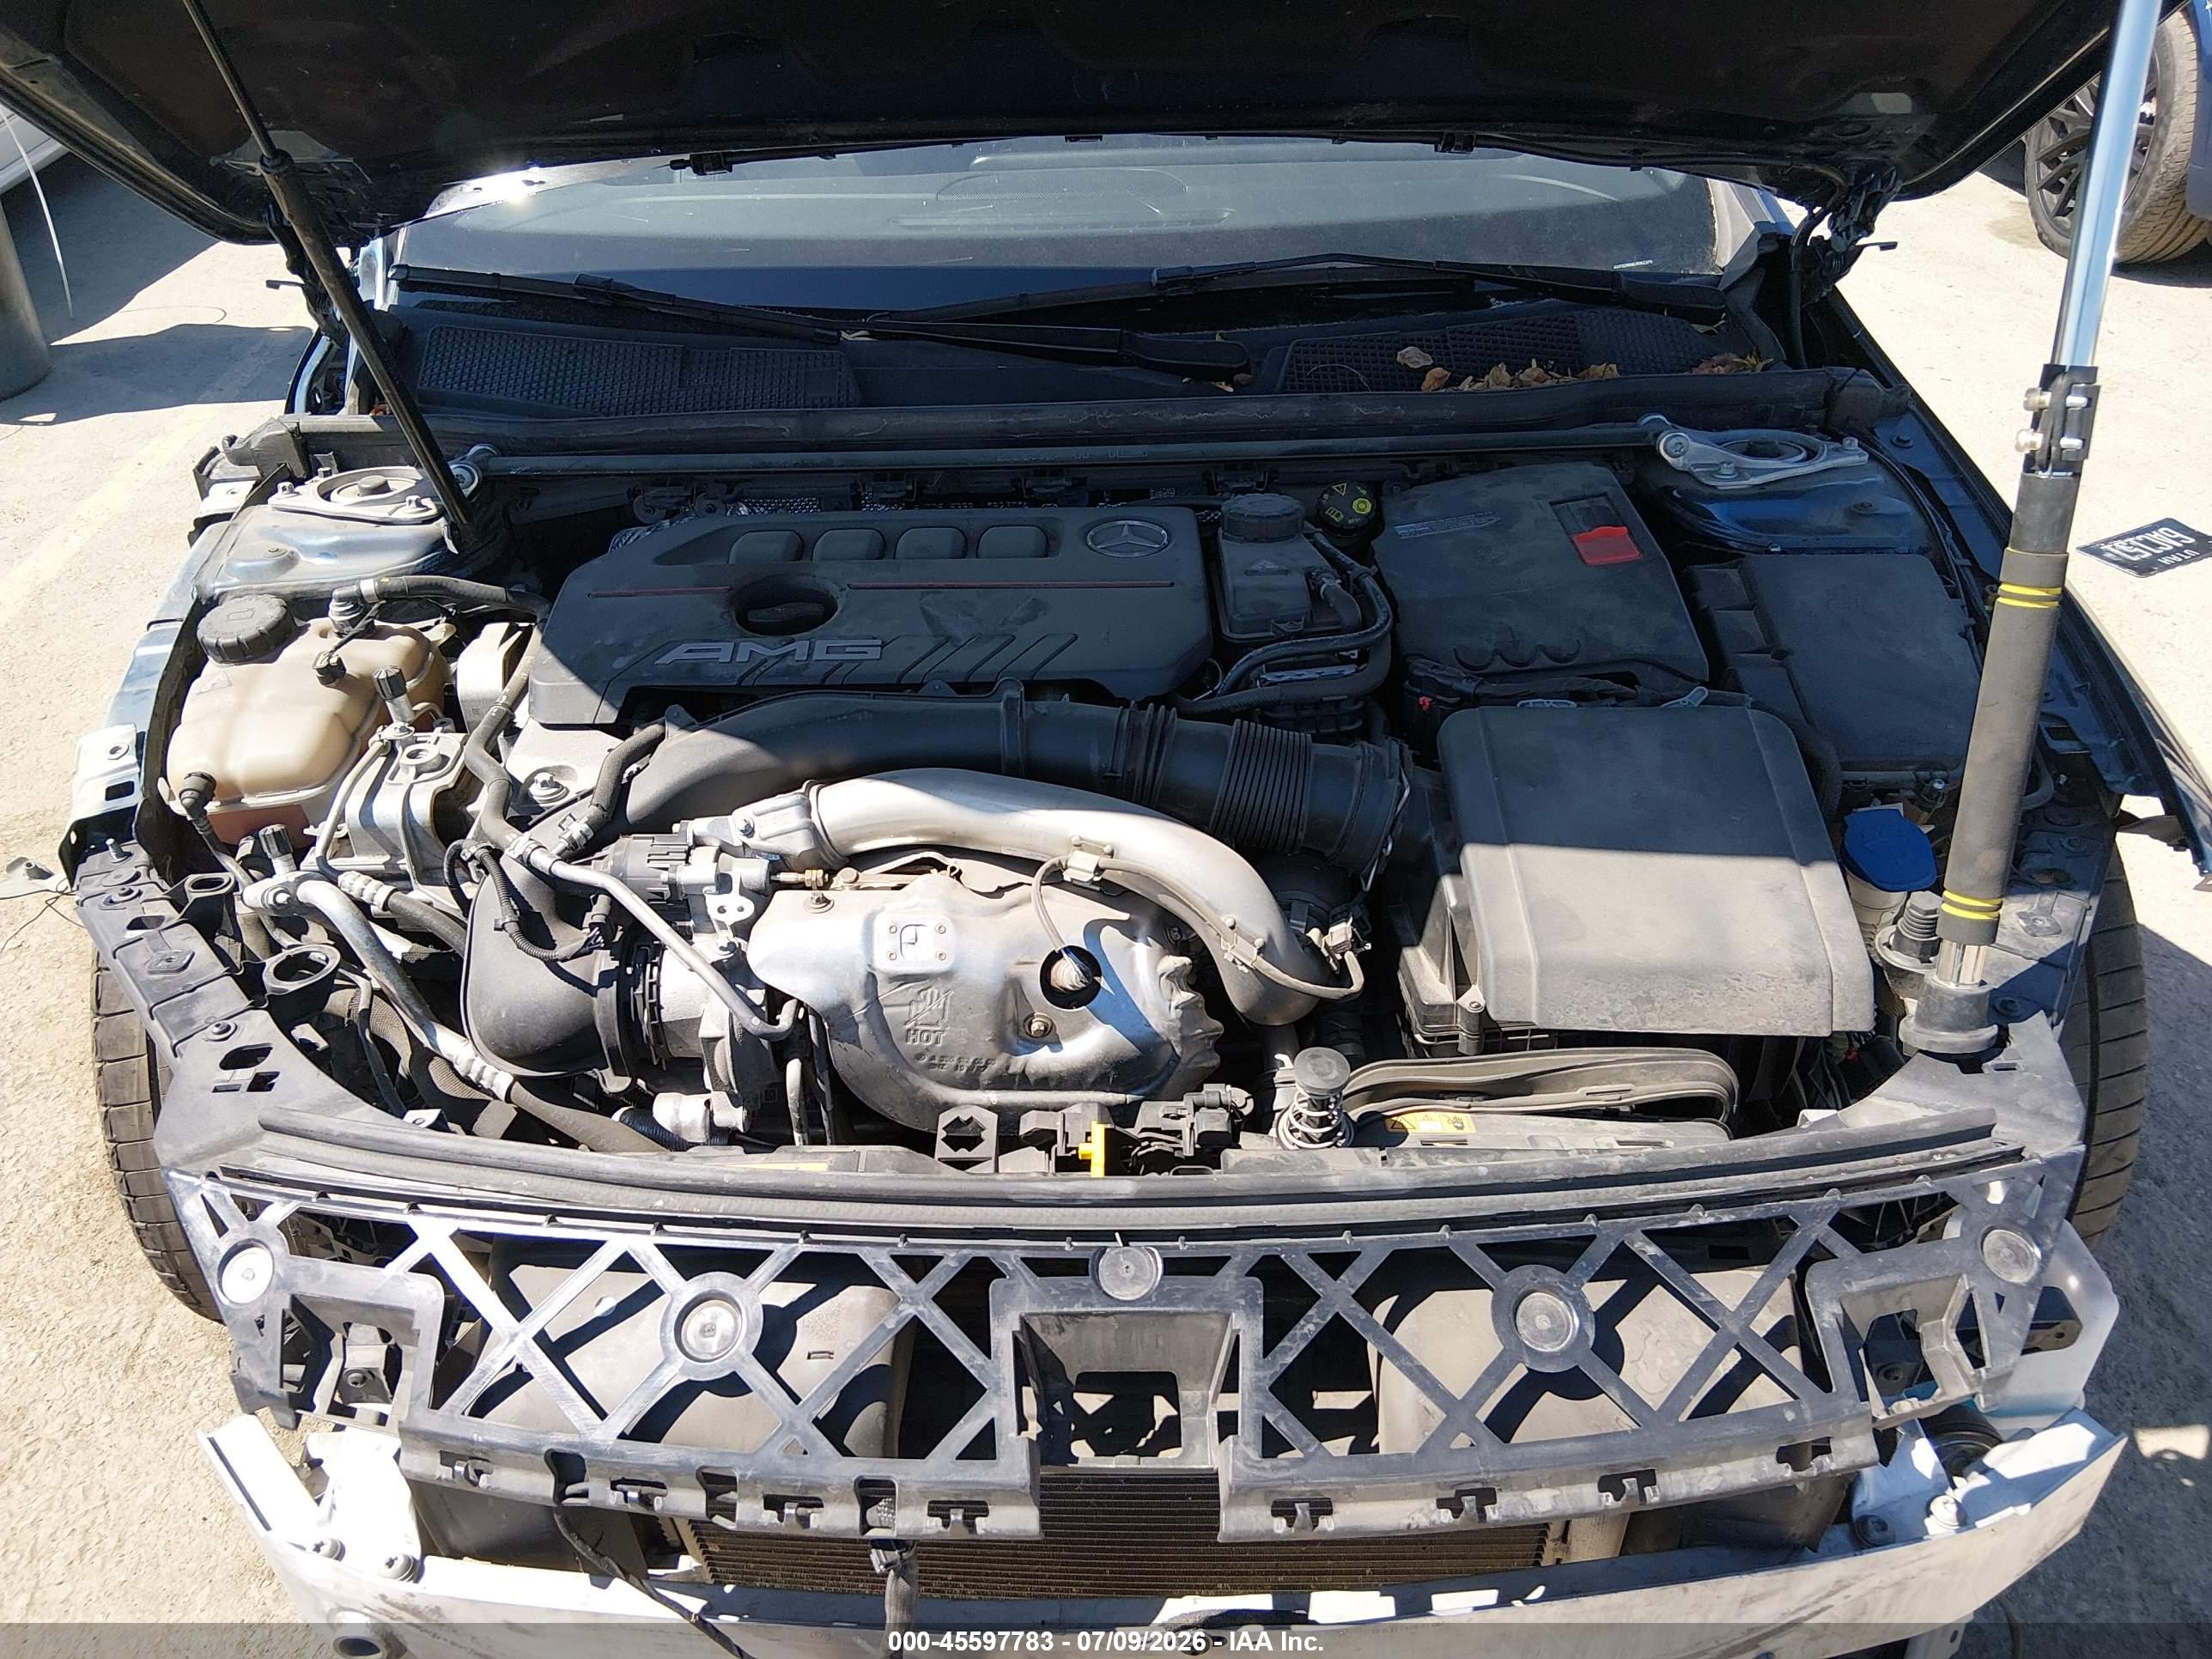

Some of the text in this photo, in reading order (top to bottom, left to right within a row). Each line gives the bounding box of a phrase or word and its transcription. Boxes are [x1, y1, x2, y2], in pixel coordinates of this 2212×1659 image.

[2157, 550, 2200, 564] UTAH
[654, 639, 883, 665] AMG
[906, 1029, 945, 1045] HOT
